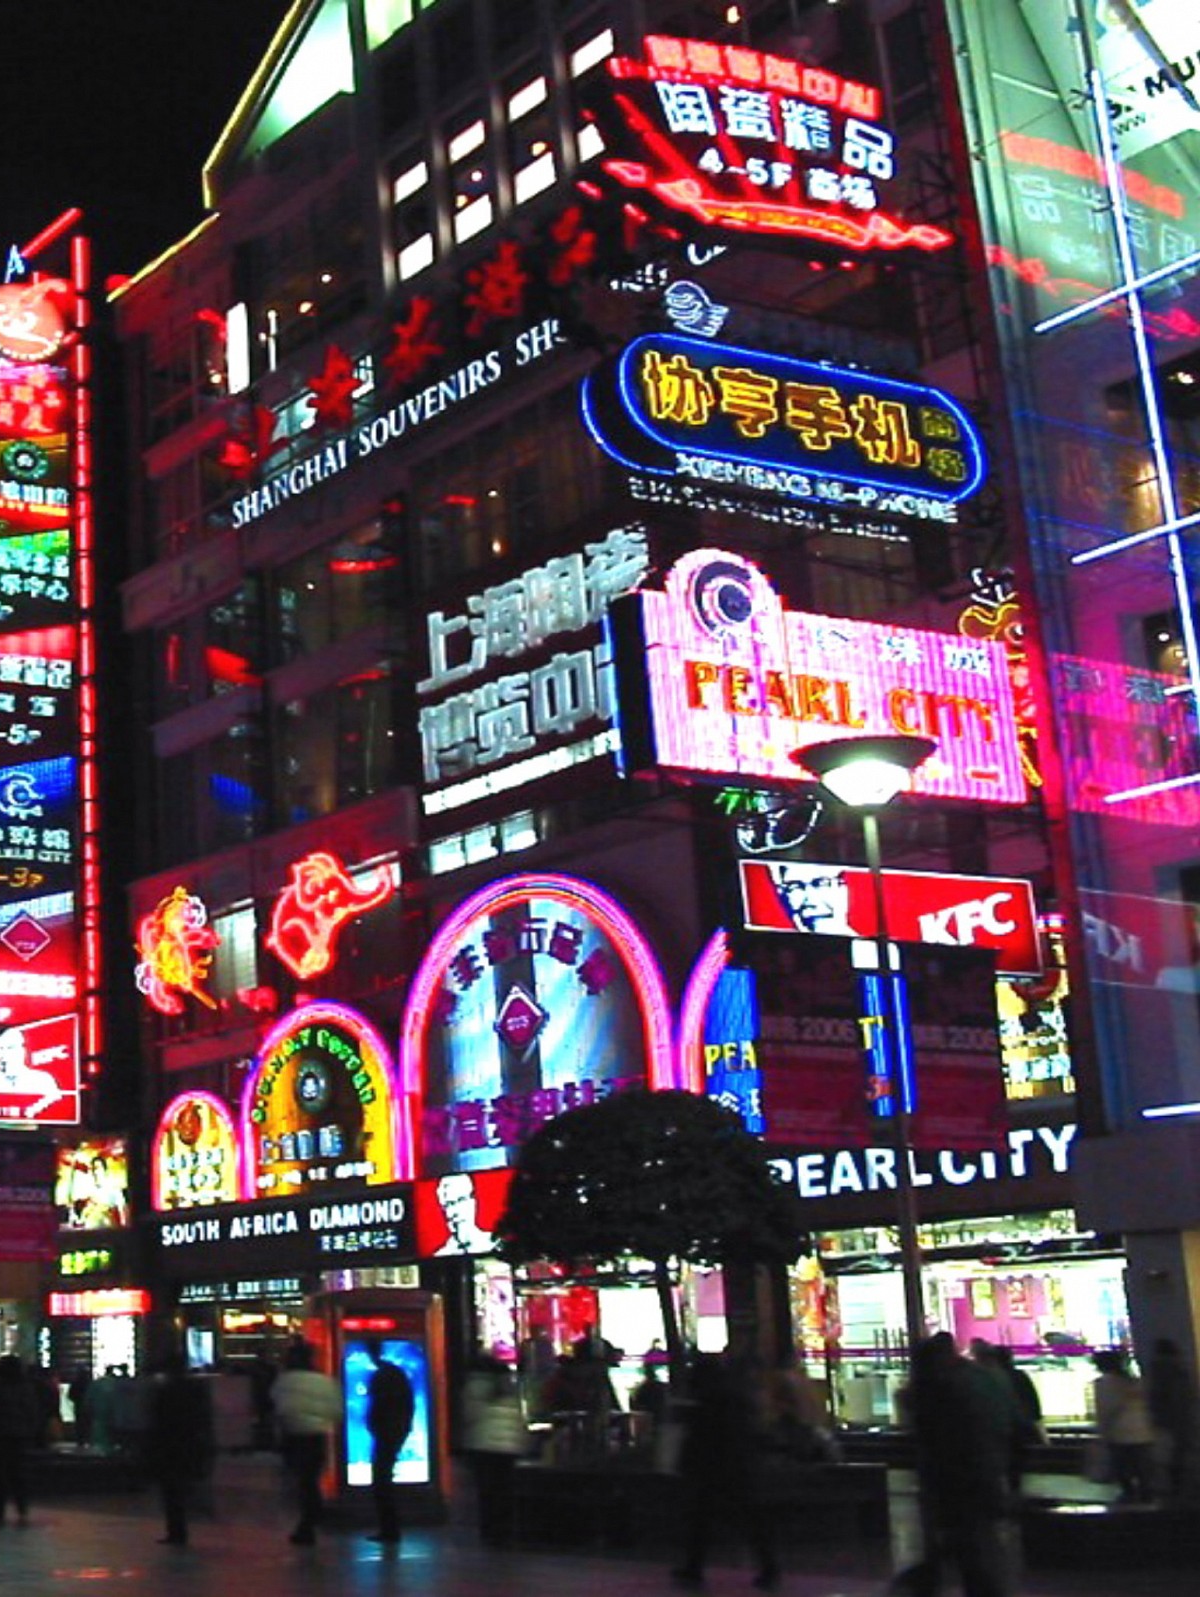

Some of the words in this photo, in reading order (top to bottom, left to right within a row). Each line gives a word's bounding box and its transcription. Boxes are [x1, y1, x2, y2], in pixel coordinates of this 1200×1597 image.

[231, 450, 348, 529] SHANGHAI
[357, 350, 502, 457] SOUVENIRS
[643, 350, 922, 467] 协亨手机
[683, 660, 866, 729] PEARL
[887, 685, 995, 744] CITY
[917, 892, 1017, 946] KFC
[161, 1220, 220, 1246] SOUTH
[229, 1209, 298, 1240] AFRICA
[309, 1198, 405, 1231] DIAMOND
